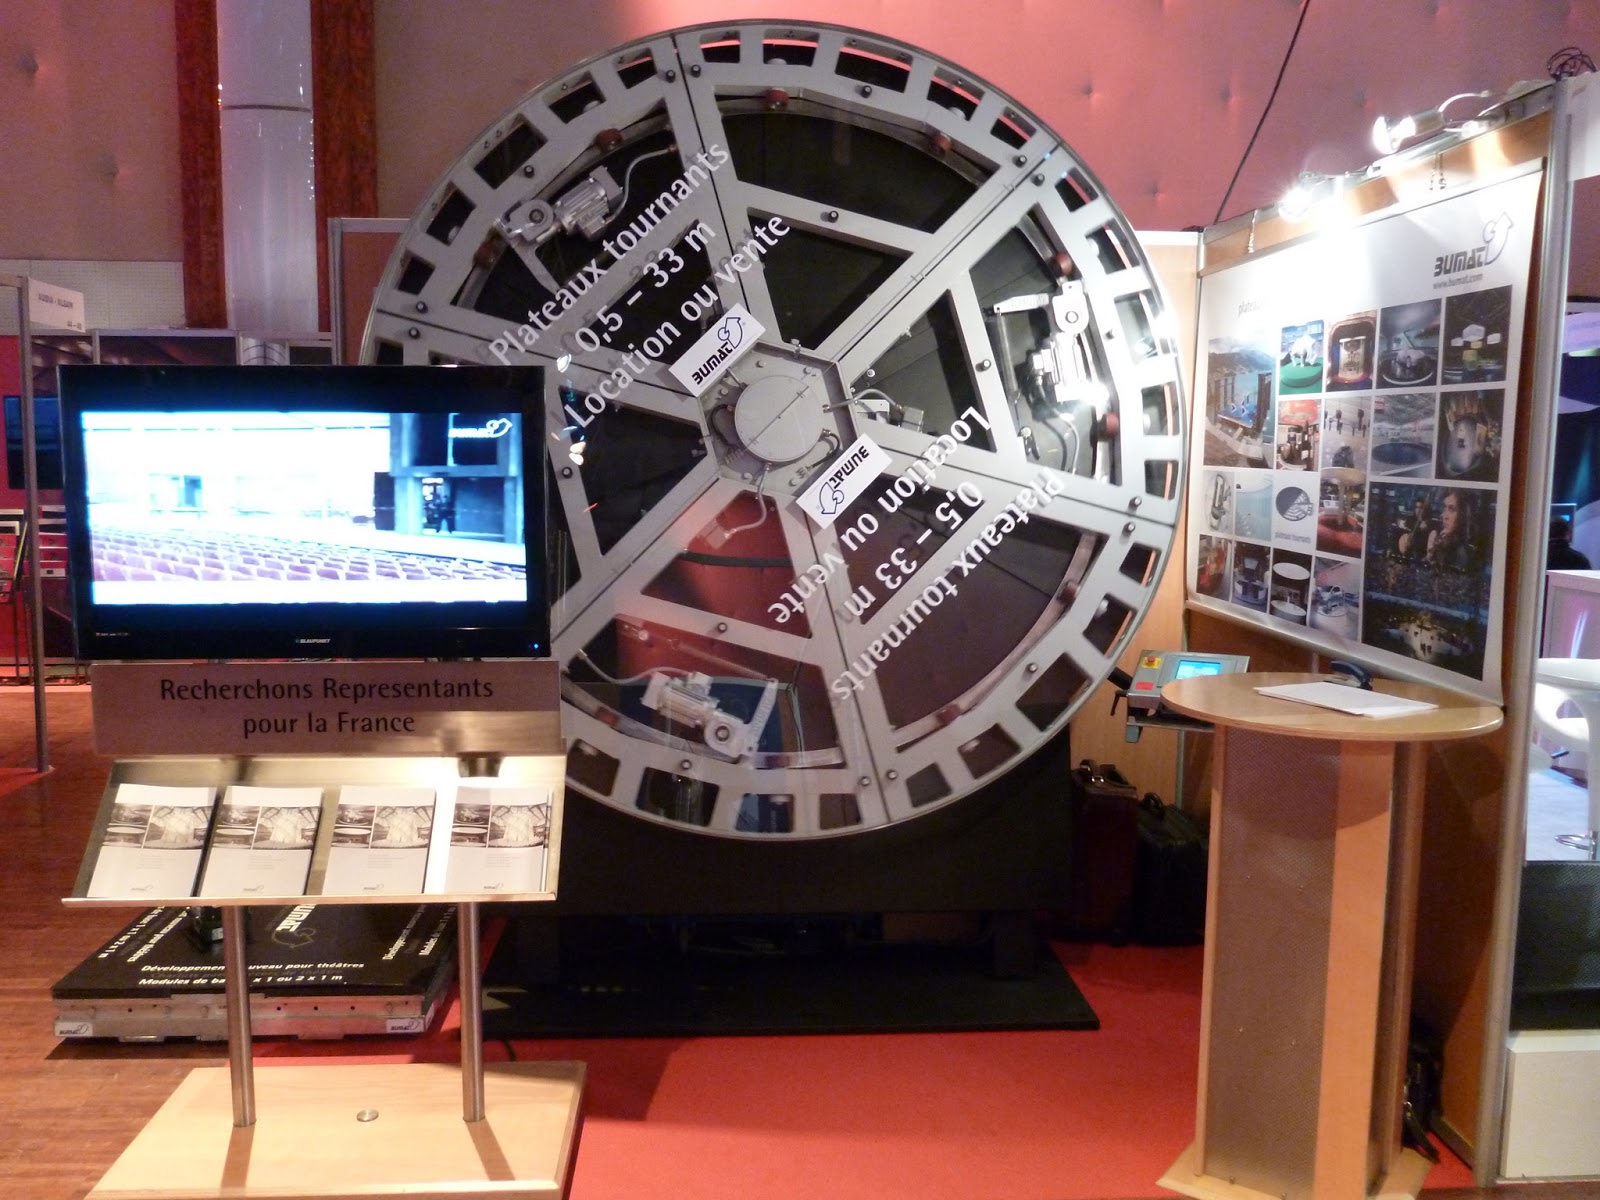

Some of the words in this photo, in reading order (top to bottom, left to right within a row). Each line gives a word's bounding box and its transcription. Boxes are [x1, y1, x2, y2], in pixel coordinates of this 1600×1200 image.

[488, 258, 608, 365] Plateaux
[602, 143, 729, 260] tournants
[575, 305, 623, 352] 0,5
[643, 247, 685, 289] 33
[684, 221, 717, 252] m
[564, 320, 682, 428] Location
[680, 284, 720, 321] ou
[715, 214, 791, 285] vente
[877, 406, 991, 514] Location
[840, 513, 879, 552] ou
[935, 481, 983, 530] 0,5
[951, 467, 1065, 578] Plateaux
[767, 551, 846, 624] vente
[874, 546, 918, 590] 33
[842, 585, 876, 618] m
[831, 574, 959, 700] tournants
[160, 679, 313, 701] Recherchons
[323, 677, 494, 704] Representants
[243, 715, 298, 739] pour
[308, 712, 328, 733] la
[338, 711, 416, 733] France
[276, 904, 317, 932] UMAT
